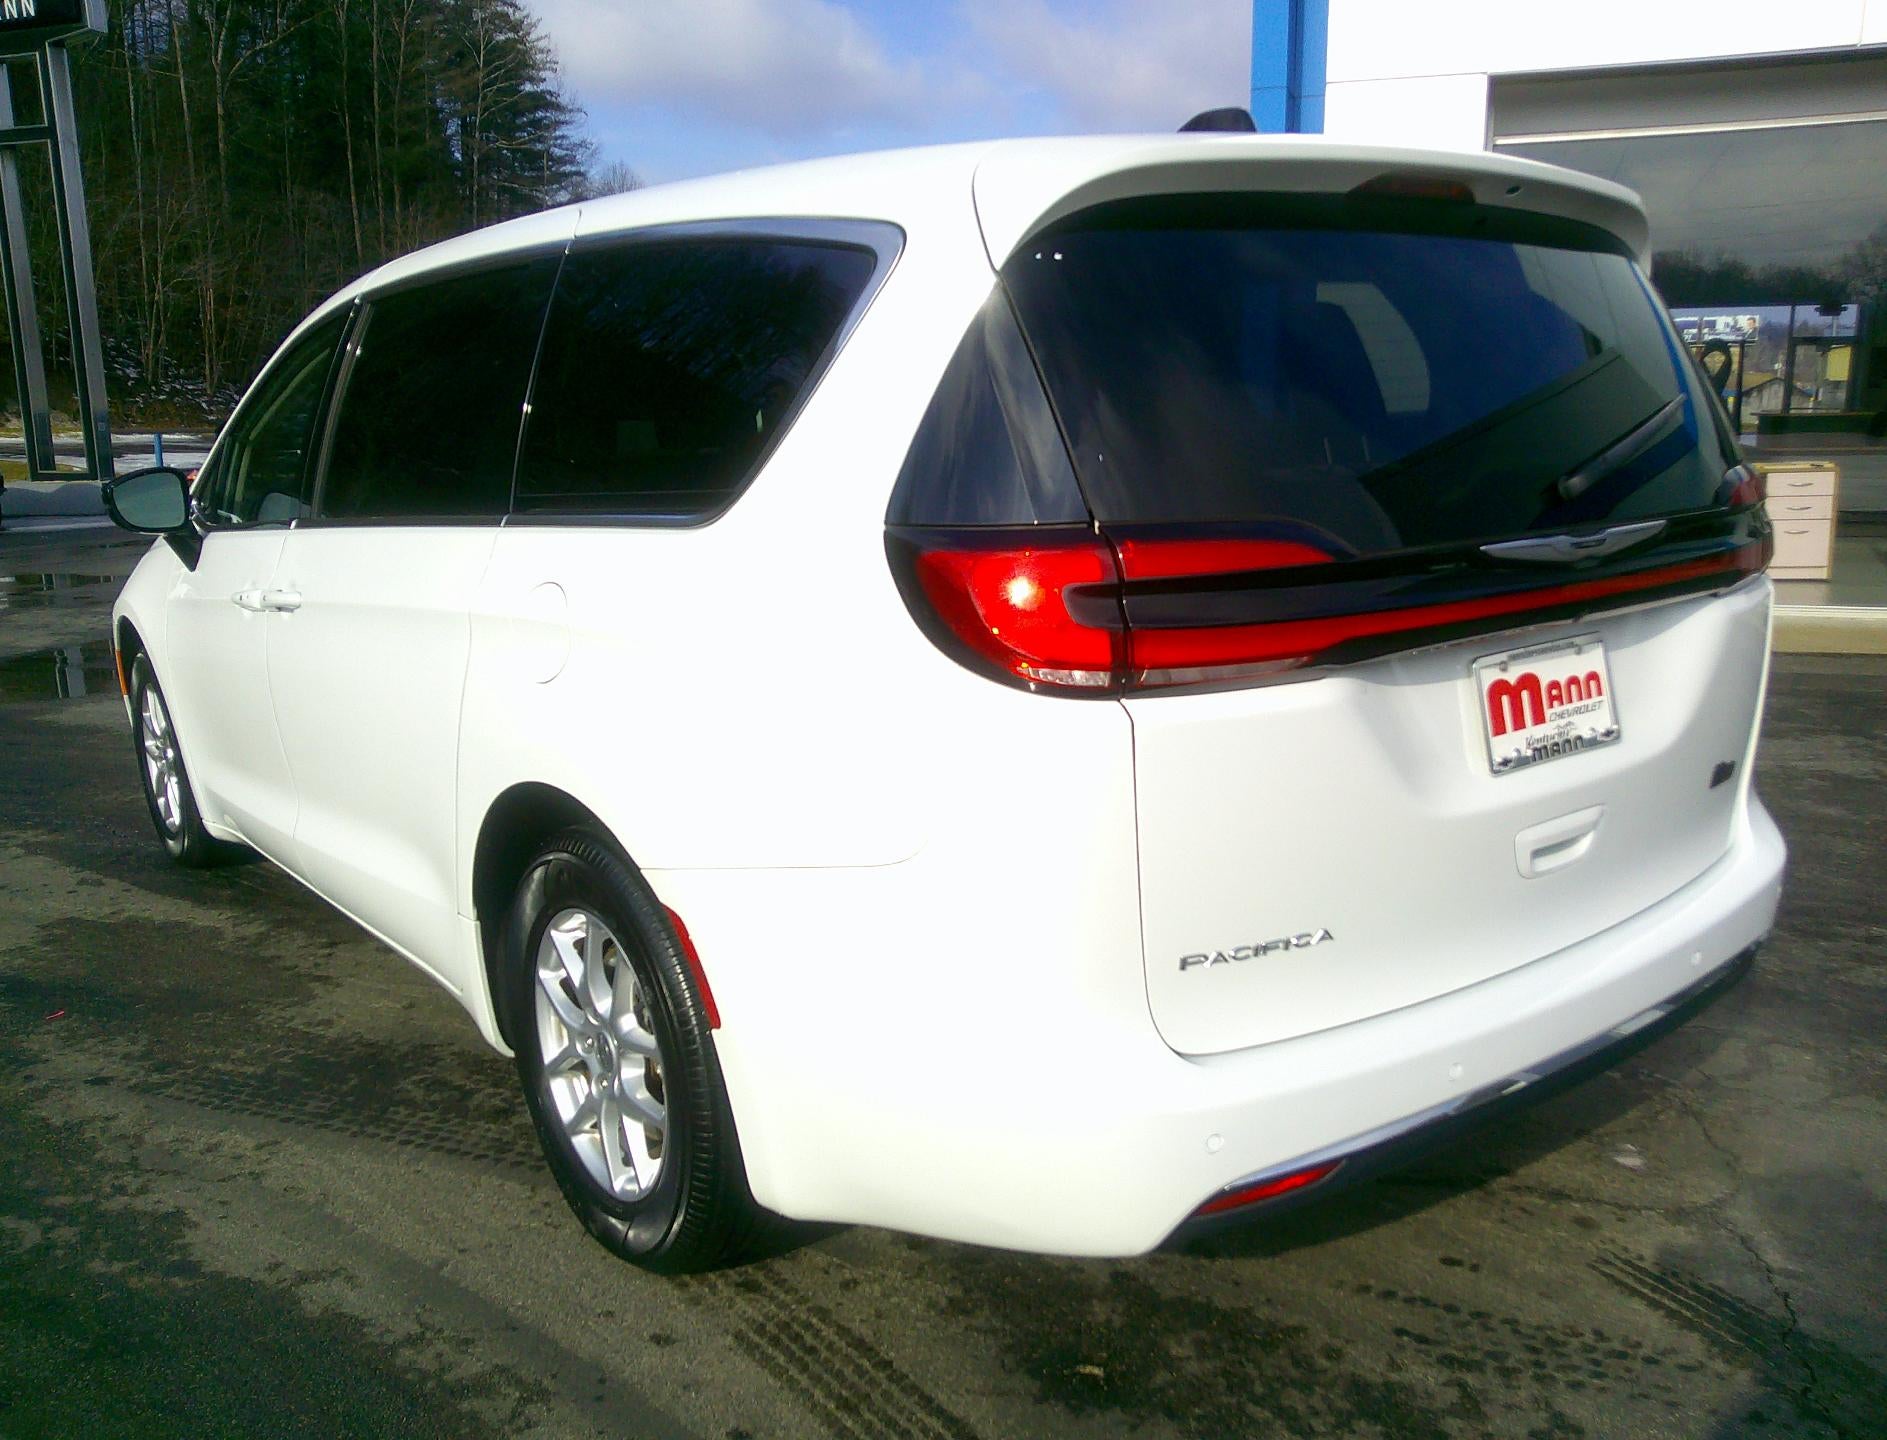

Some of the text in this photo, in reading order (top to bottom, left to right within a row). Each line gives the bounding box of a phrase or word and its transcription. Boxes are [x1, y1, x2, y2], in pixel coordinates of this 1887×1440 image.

[0, 0, 35, 20] NN
[1549, 701, 1604, 721] CHEVROLET
[1179, 929, 1334, 971] PACIFICA
